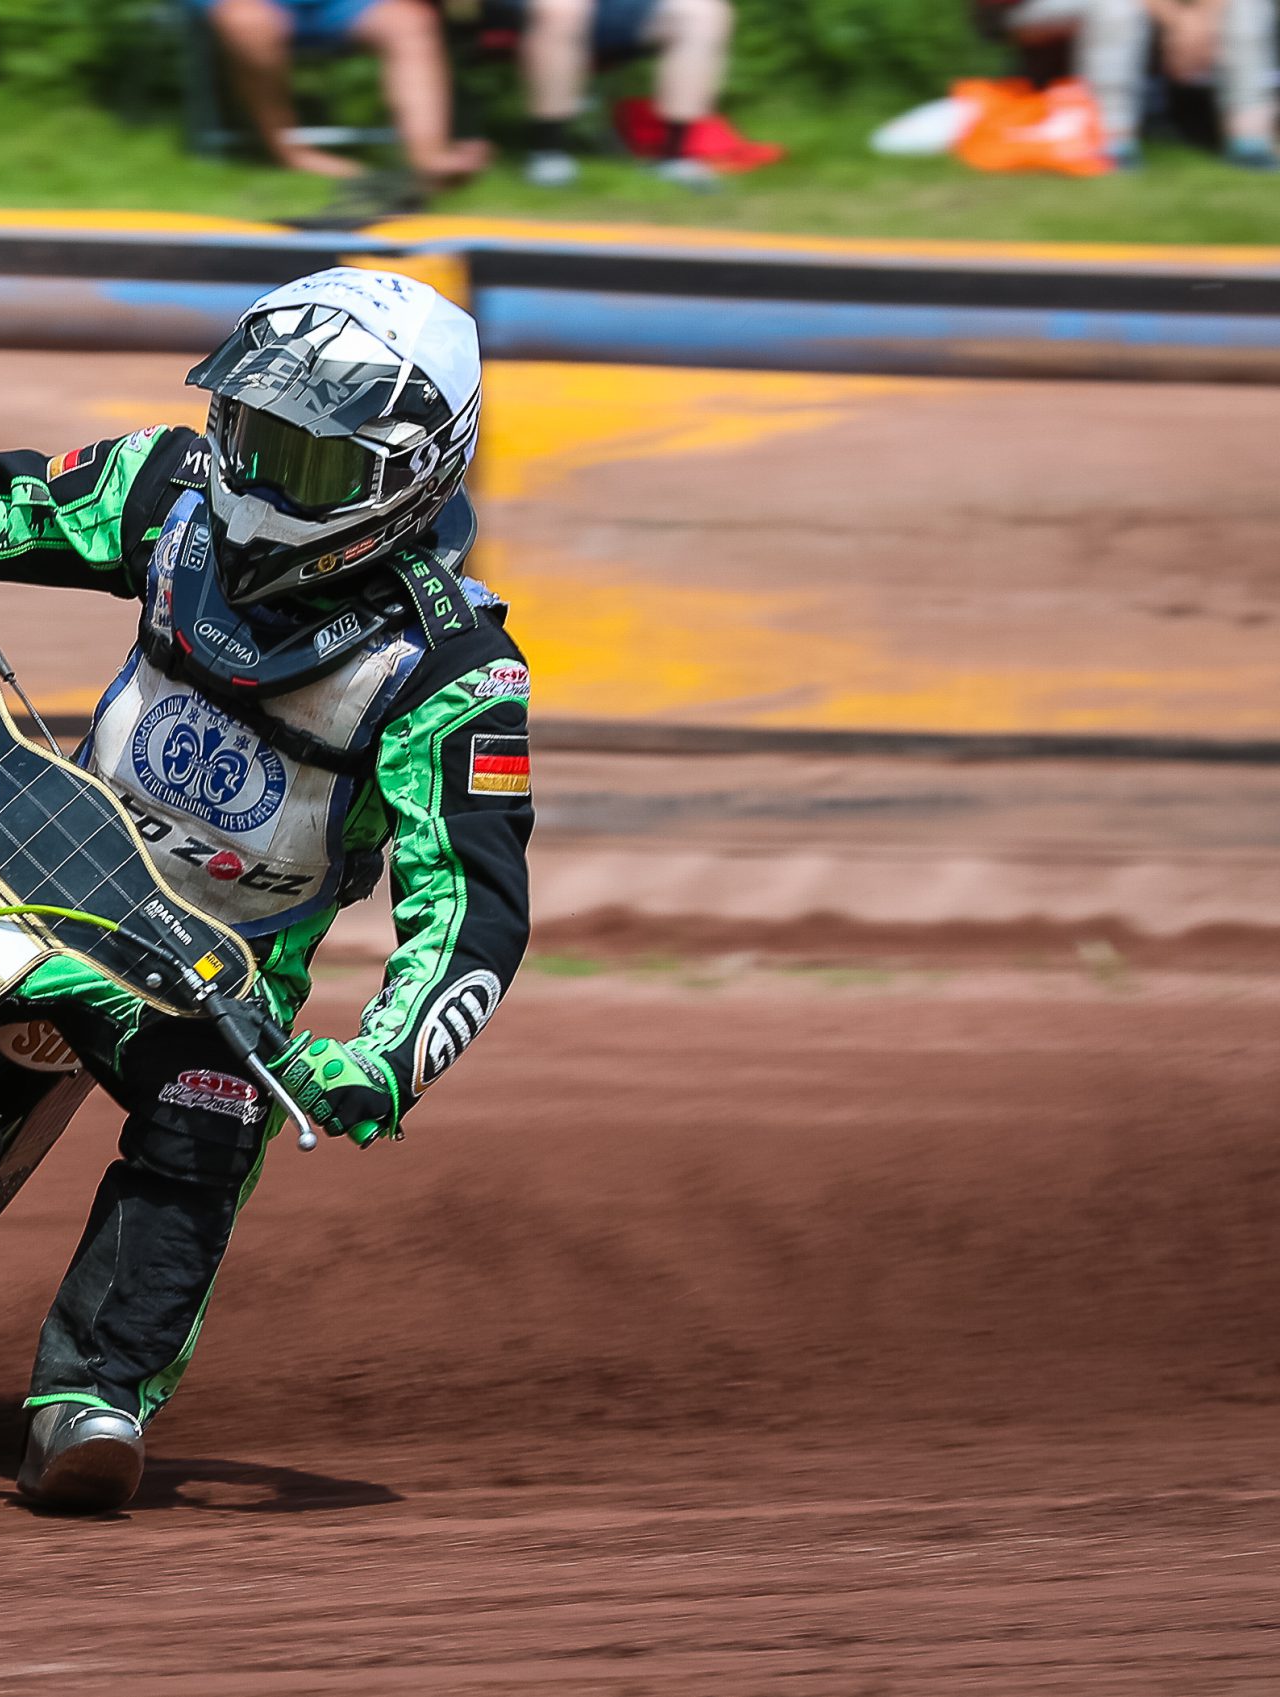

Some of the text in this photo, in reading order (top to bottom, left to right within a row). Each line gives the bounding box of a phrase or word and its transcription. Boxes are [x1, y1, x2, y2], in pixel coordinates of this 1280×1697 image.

[198, 623, 254, 664] ORTEMA
[134, 697, 184, 763] MOTORSPORT
[139, 767, 213, 821] VEREINIGUNG
[220, 790, 282, 830] HERXHEIM
